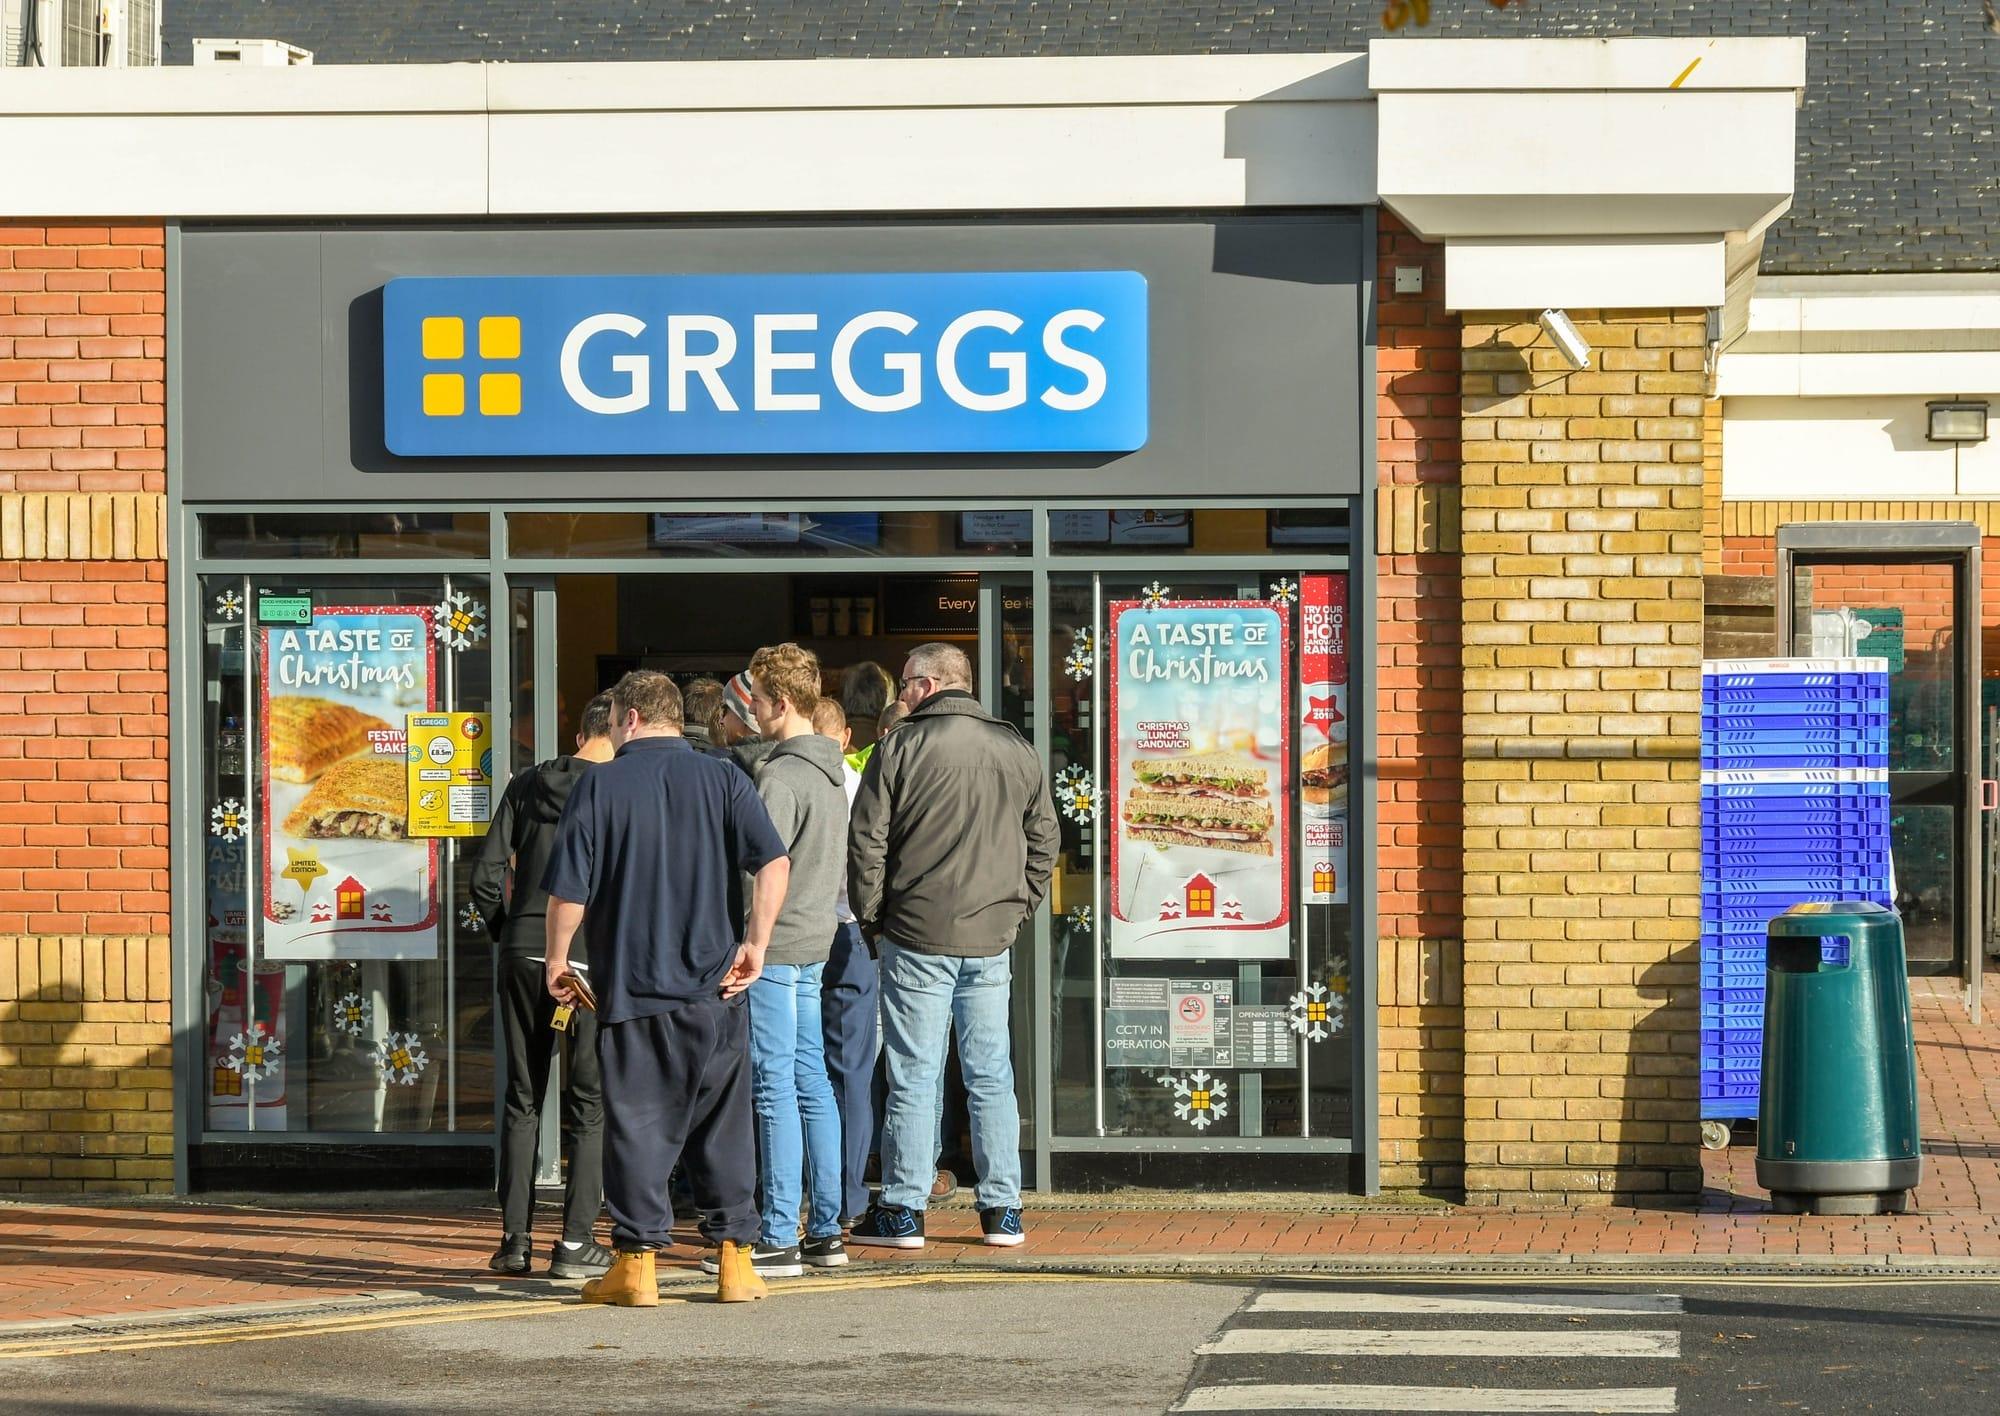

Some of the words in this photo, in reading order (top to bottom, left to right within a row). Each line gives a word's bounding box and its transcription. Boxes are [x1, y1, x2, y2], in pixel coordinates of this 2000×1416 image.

[560, 309, 1107, 414] GREGGS
[938, 597, 976, 613] Every
[1304, 605, 1321, 613] TRY
[1323, 605, 1343, 613] OUR
[1304, 614, 1323, 624] HO
[1325, 614, 1343, 624] HO
[1129, 624, 1151, 645] A
[1156, 624, 1234, 645] TASTE
[1244, 627, 1267, 641] OF
[1304, 624, 1343, 639] HOT
[280, 630, 300, 651] A
[305, 630, 380, 651] TASTE
[391, 633, 413, 647] OF
[1304, 646, 1343, 655] RANGE
[1129, 646, 1269, 684] Christmas
[280, 652, 415, 689] Christmas
[1137, 722, 1189, 730] CHRISTMAS
[368, 731, 407, 741] FESTIV
[1148, 731, 1179, 739] LUNCH
[374, 743, 408, 753] BAKE
[1137, 740, 1189, 748] SANDWICH
[1115, 1025, 1147, 1035] CCTV
[1150, 1025, 1163, 1035] IN
[1106, 1039, 1170, 1049] OPERATION
